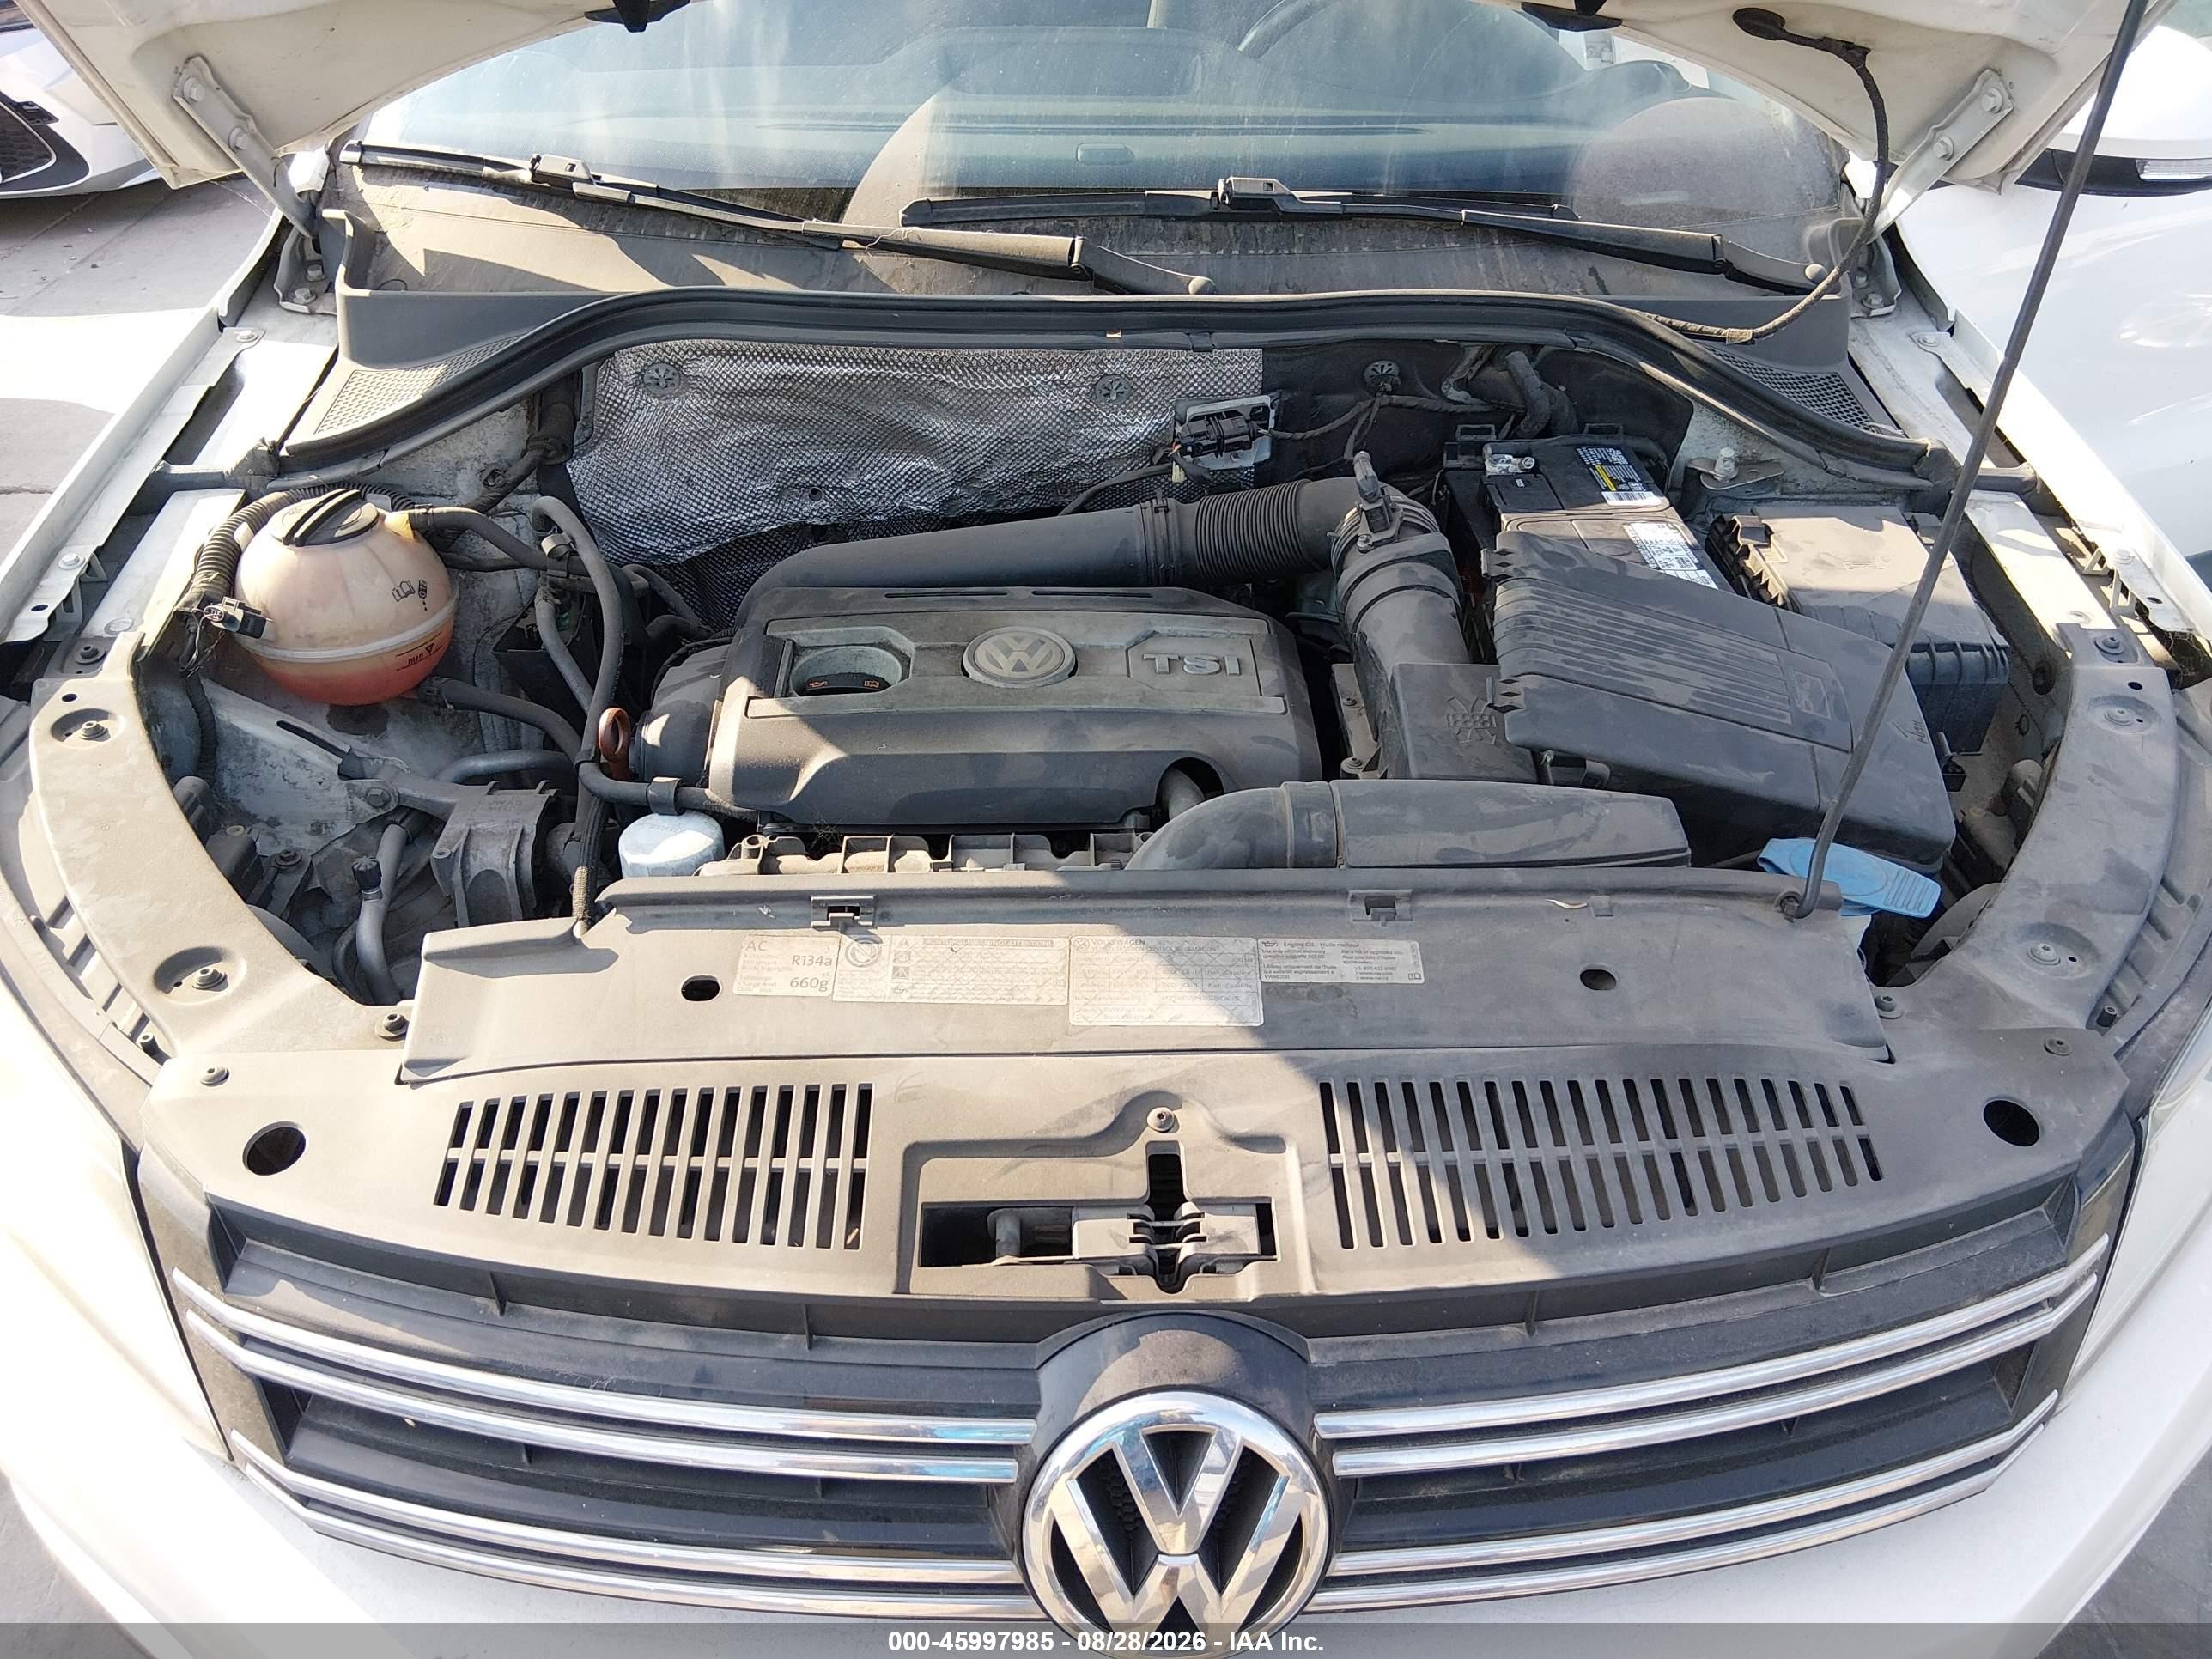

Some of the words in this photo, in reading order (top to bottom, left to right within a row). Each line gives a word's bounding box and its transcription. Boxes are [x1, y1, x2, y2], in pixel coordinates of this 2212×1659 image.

[408, 653, 424, 665] min
[1143, 653, 1242, 675] TSI
[745, 940, 768, 951] AC
[791, 955, 833, 967] R134a
[790, 977, 829, 993] 660g
